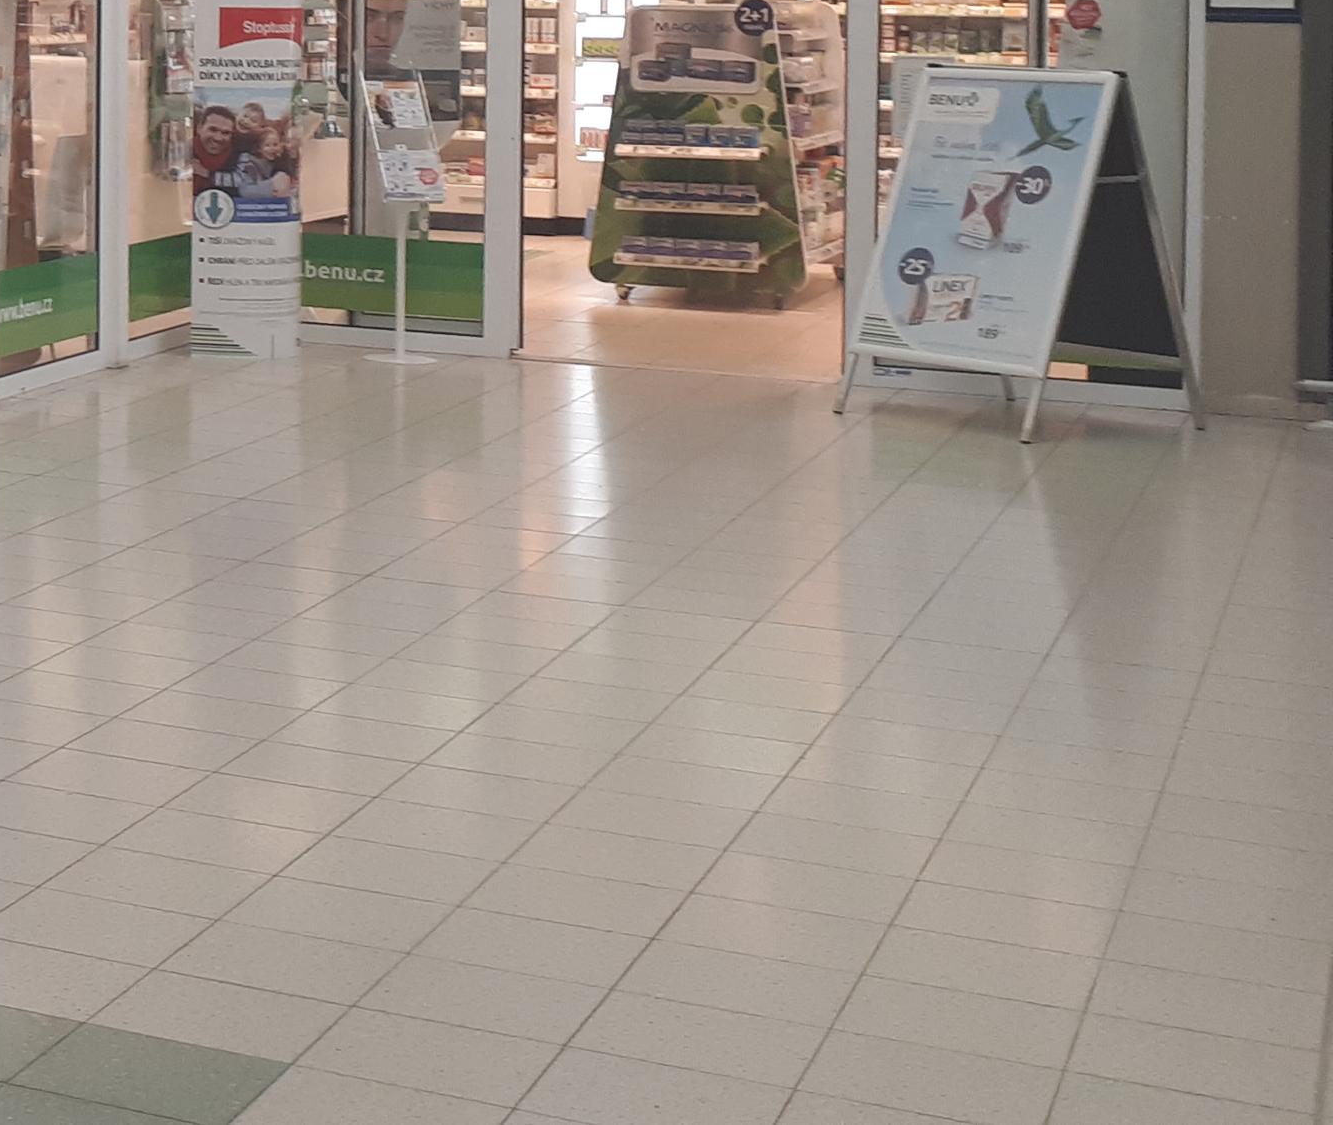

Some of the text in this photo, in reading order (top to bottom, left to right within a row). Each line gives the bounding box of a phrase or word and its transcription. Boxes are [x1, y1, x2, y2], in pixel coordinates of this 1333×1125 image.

[737, 6, 770, 23] 2+1
[224, 72, 231, 82] 2
[928, 93, 967, 108] BENU
